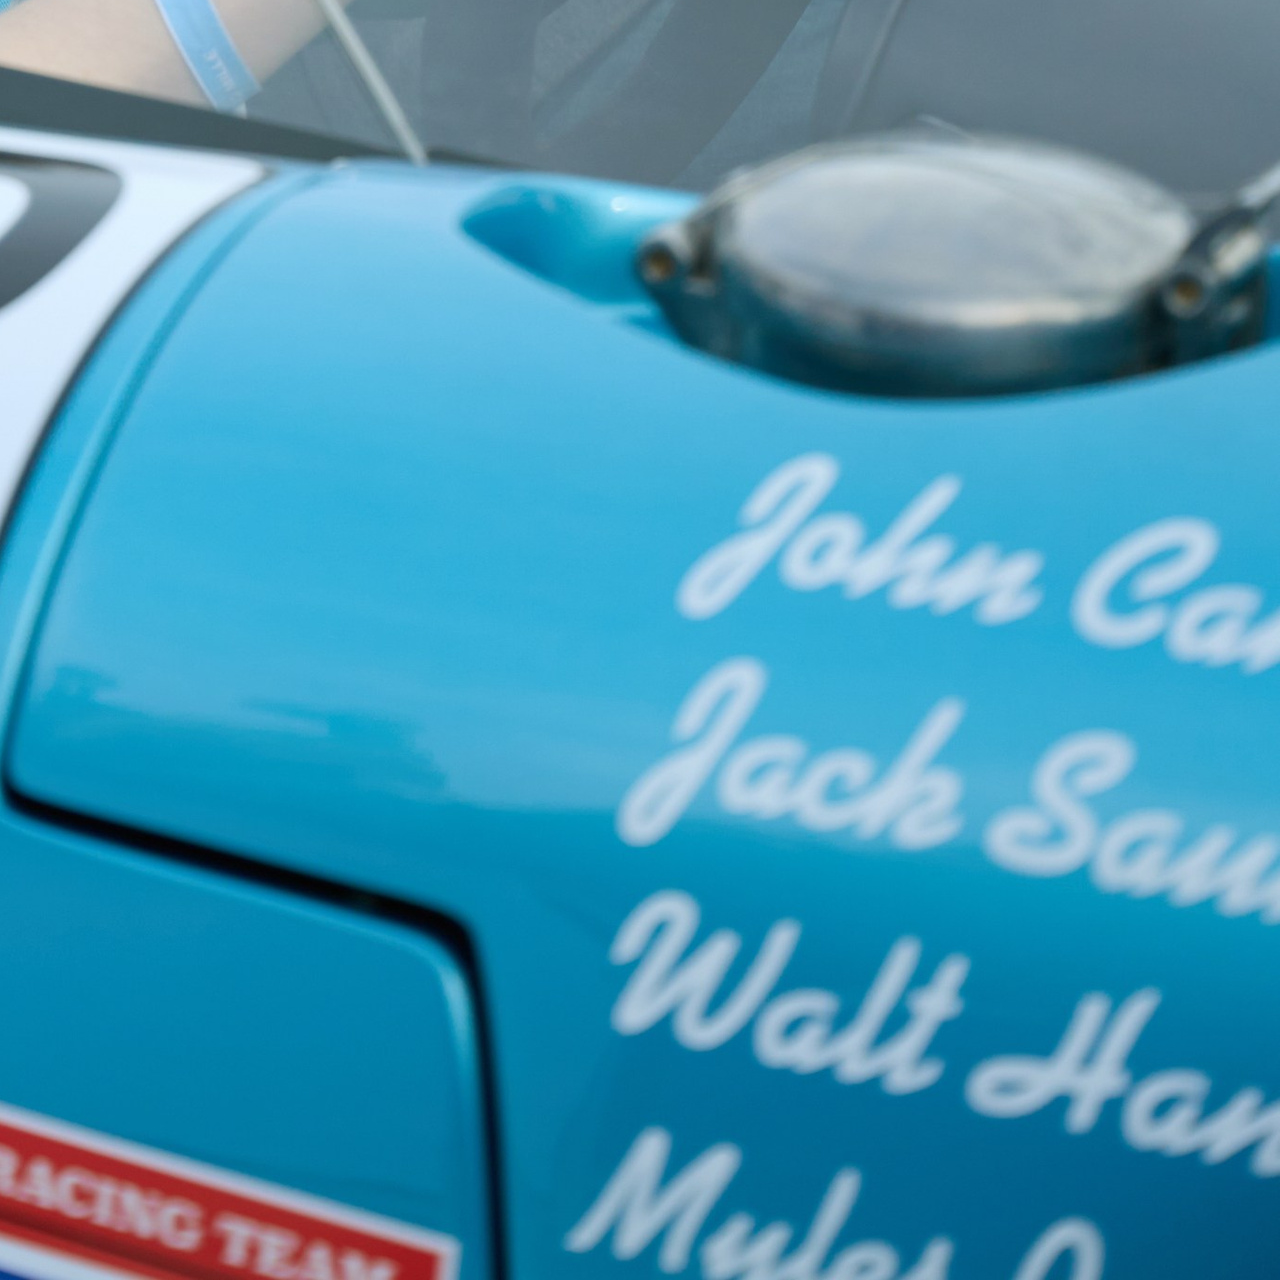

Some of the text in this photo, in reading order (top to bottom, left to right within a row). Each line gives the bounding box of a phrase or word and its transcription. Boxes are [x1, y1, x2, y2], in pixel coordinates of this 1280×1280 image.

[676, 451, 1044, 625] John
[616, 656, 1280, 926] Jack Sau
[610, 889, 970, 1096] Walt
